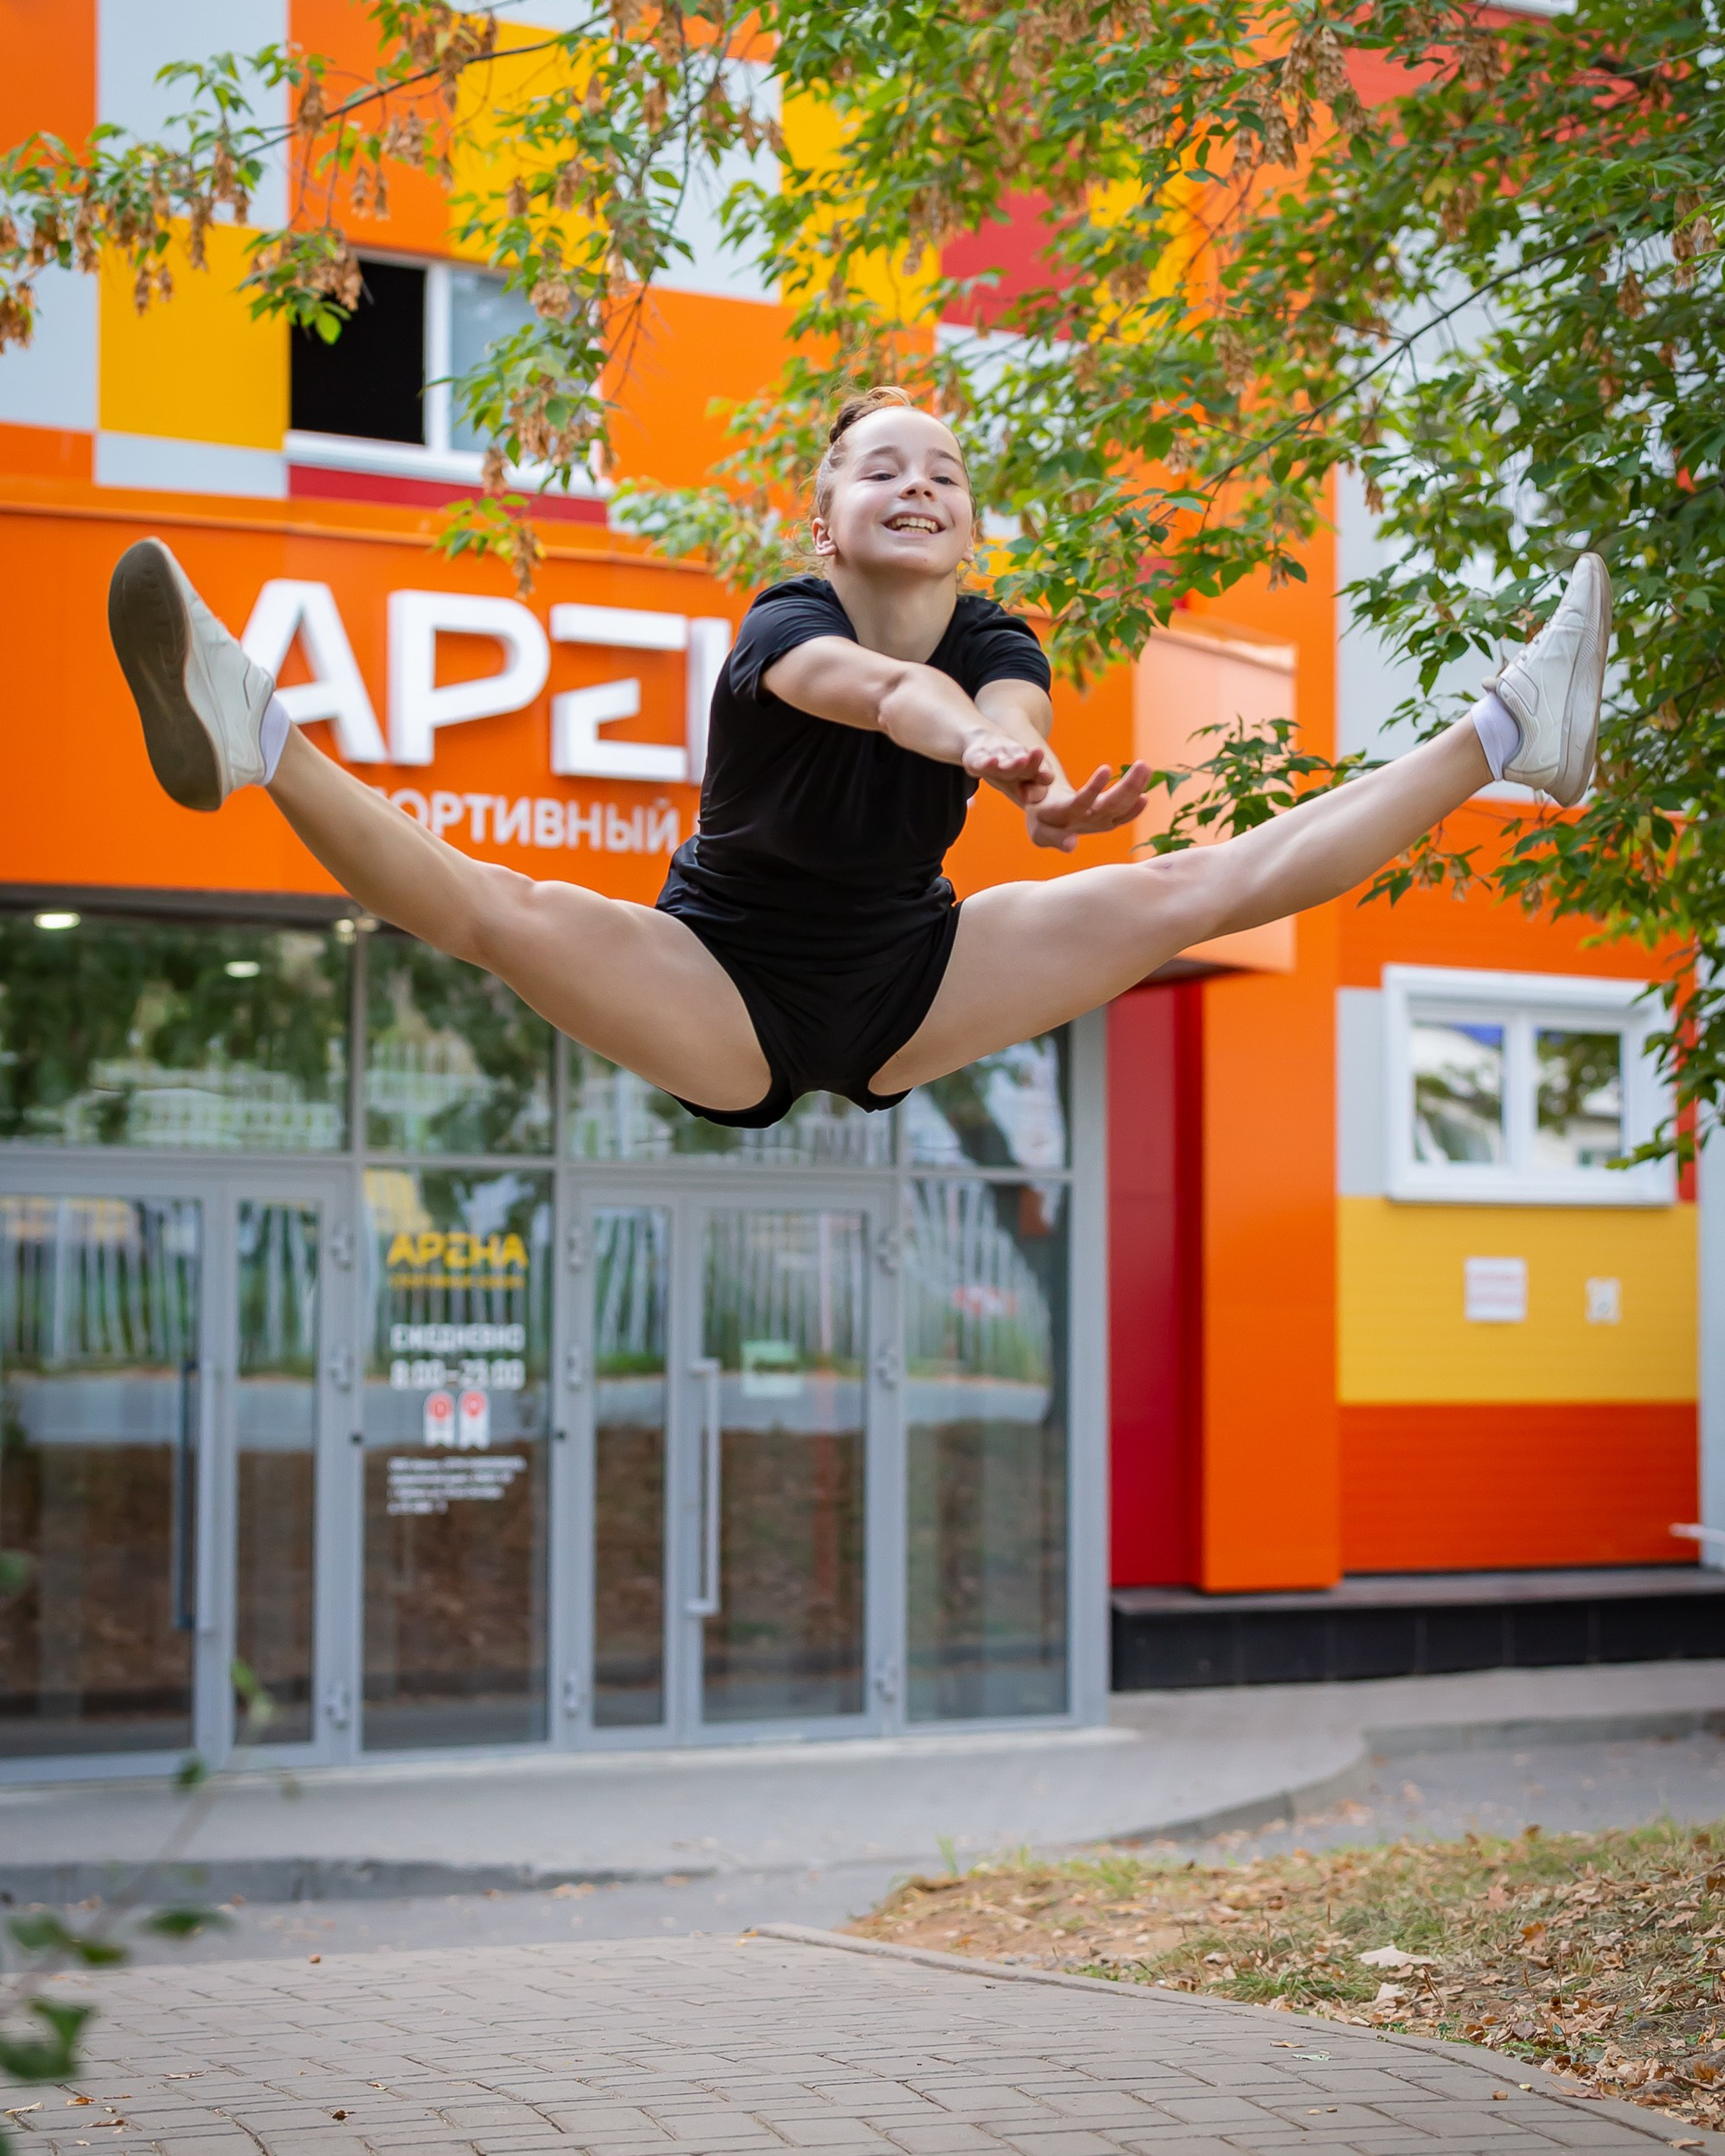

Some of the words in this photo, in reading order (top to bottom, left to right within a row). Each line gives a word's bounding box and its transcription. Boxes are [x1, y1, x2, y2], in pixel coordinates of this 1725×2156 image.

[241, 579, 732, 787] АРЕ
[371, 787, 681, 854] ОРТИВНЫЙ
[387, 1232, 529, 1268] АРЕНА
